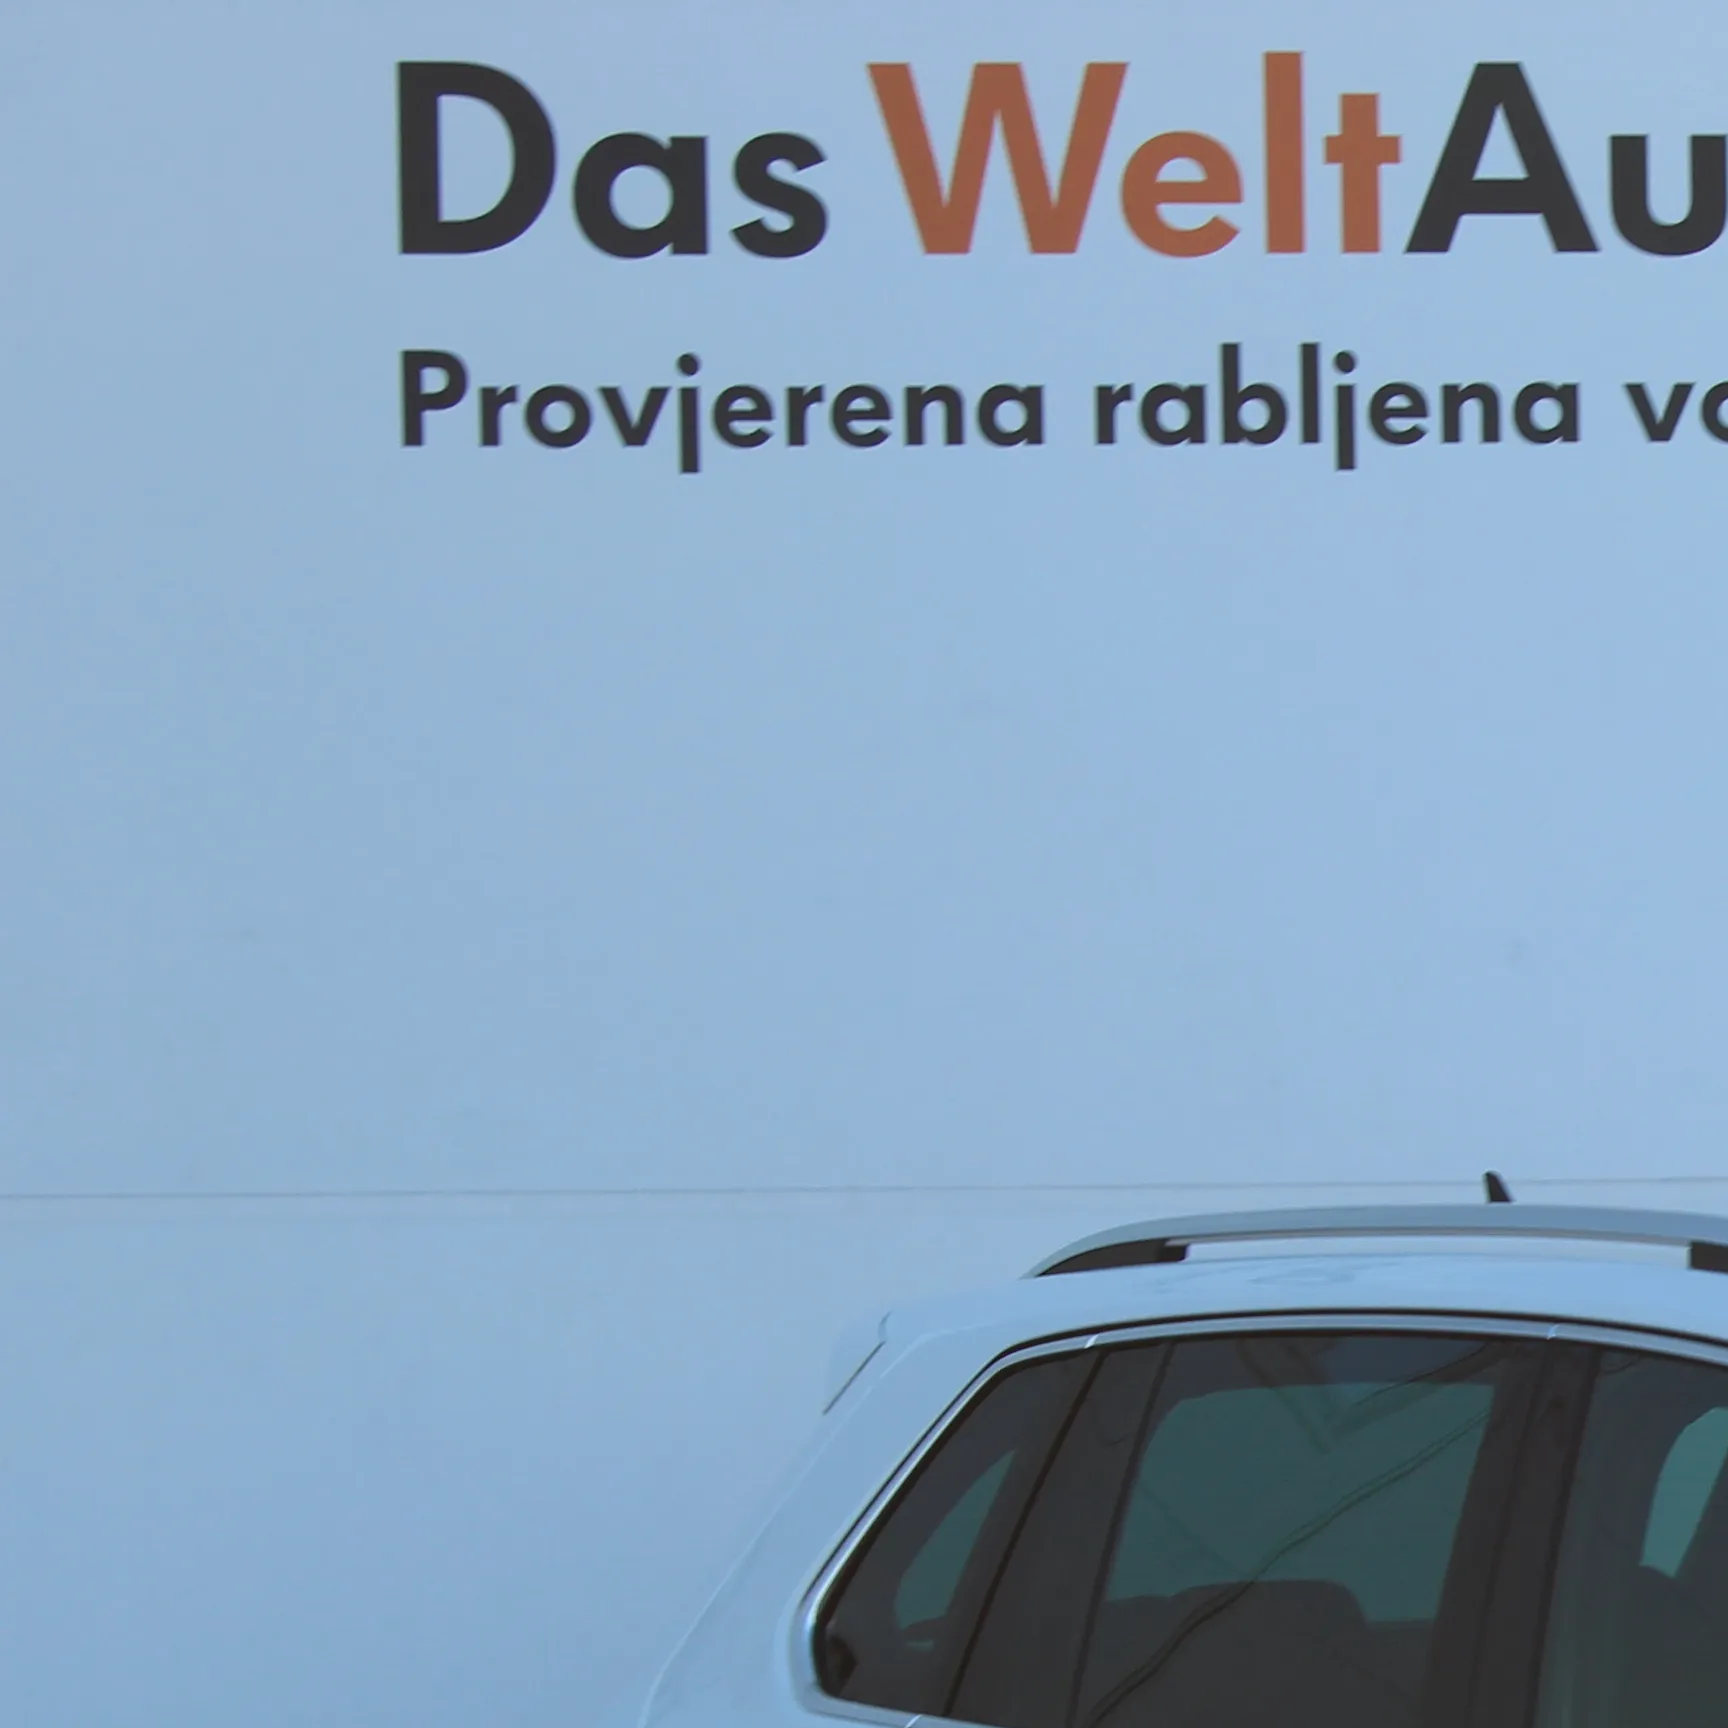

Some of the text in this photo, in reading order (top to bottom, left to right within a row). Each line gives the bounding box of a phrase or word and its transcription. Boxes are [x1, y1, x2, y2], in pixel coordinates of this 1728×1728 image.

[397, 60, 828, 259] Das
[400, 348, 1044, 475] Provjerena
[1094, 342, 1579, 471] rabljena
